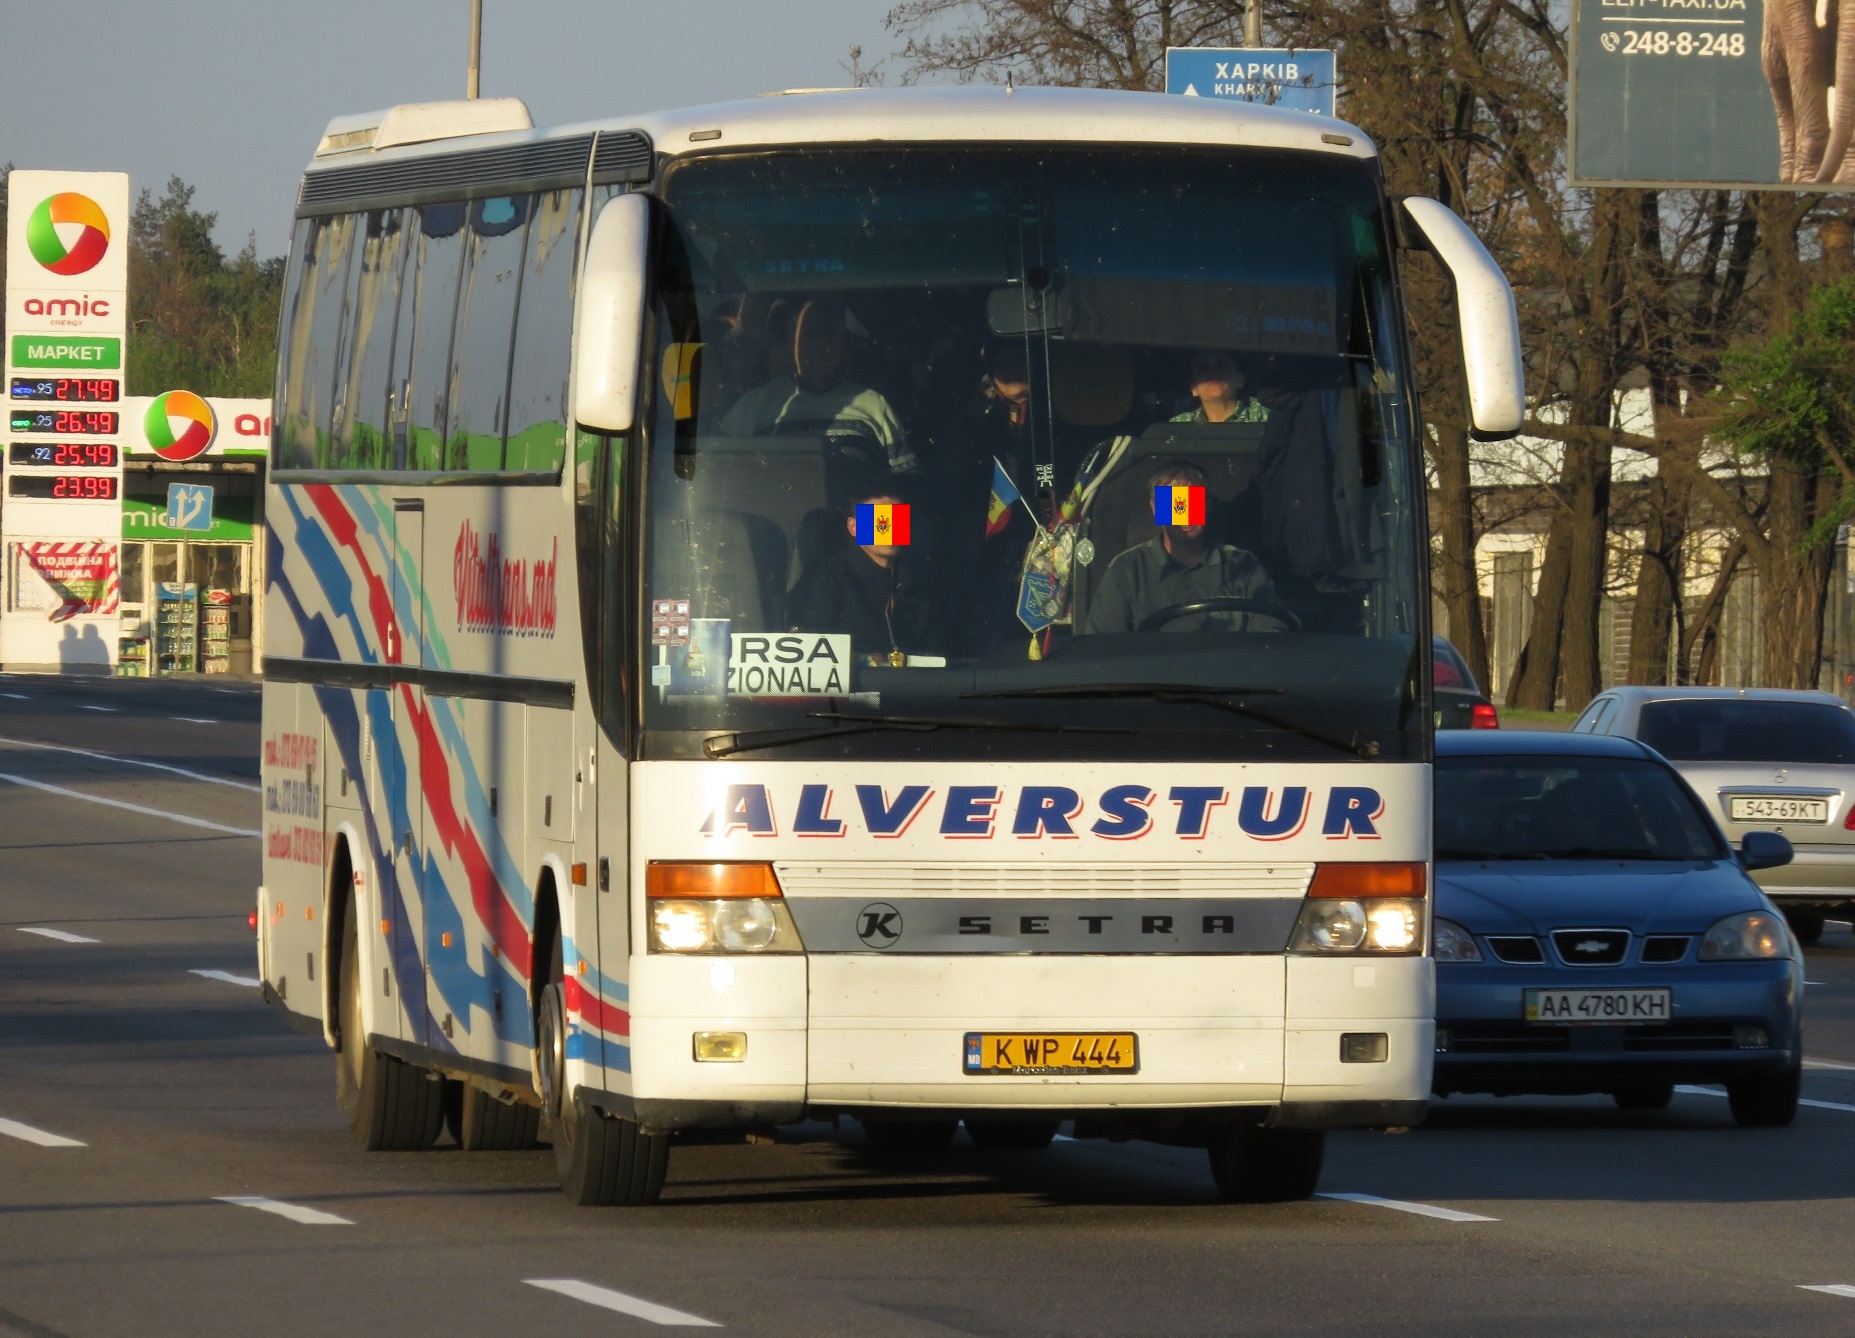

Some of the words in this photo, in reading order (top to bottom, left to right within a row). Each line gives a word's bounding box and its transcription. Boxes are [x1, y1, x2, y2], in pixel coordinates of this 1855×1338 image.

[1622, 30, 1745, 56] 248-8-248
[1215, 62, 1298, 80] ХАРКІВ
[24, 294, 110, 316] amic
[27, 345, 105, 360] МАРКЕТ
[56, 379, 113, 400] 27.49
[55, 411, 113, 432] 26.49
[54, 444, 112, 465] 25.49
[53, 477, 111, 497] 23.99
[699, 784, 1385, 841] ALVERSTUR
[958, 916, 1235, 935] SETRA
[968, 1054, 981, 1064] MD
[1071, 1037, 1121, 1065] 444
